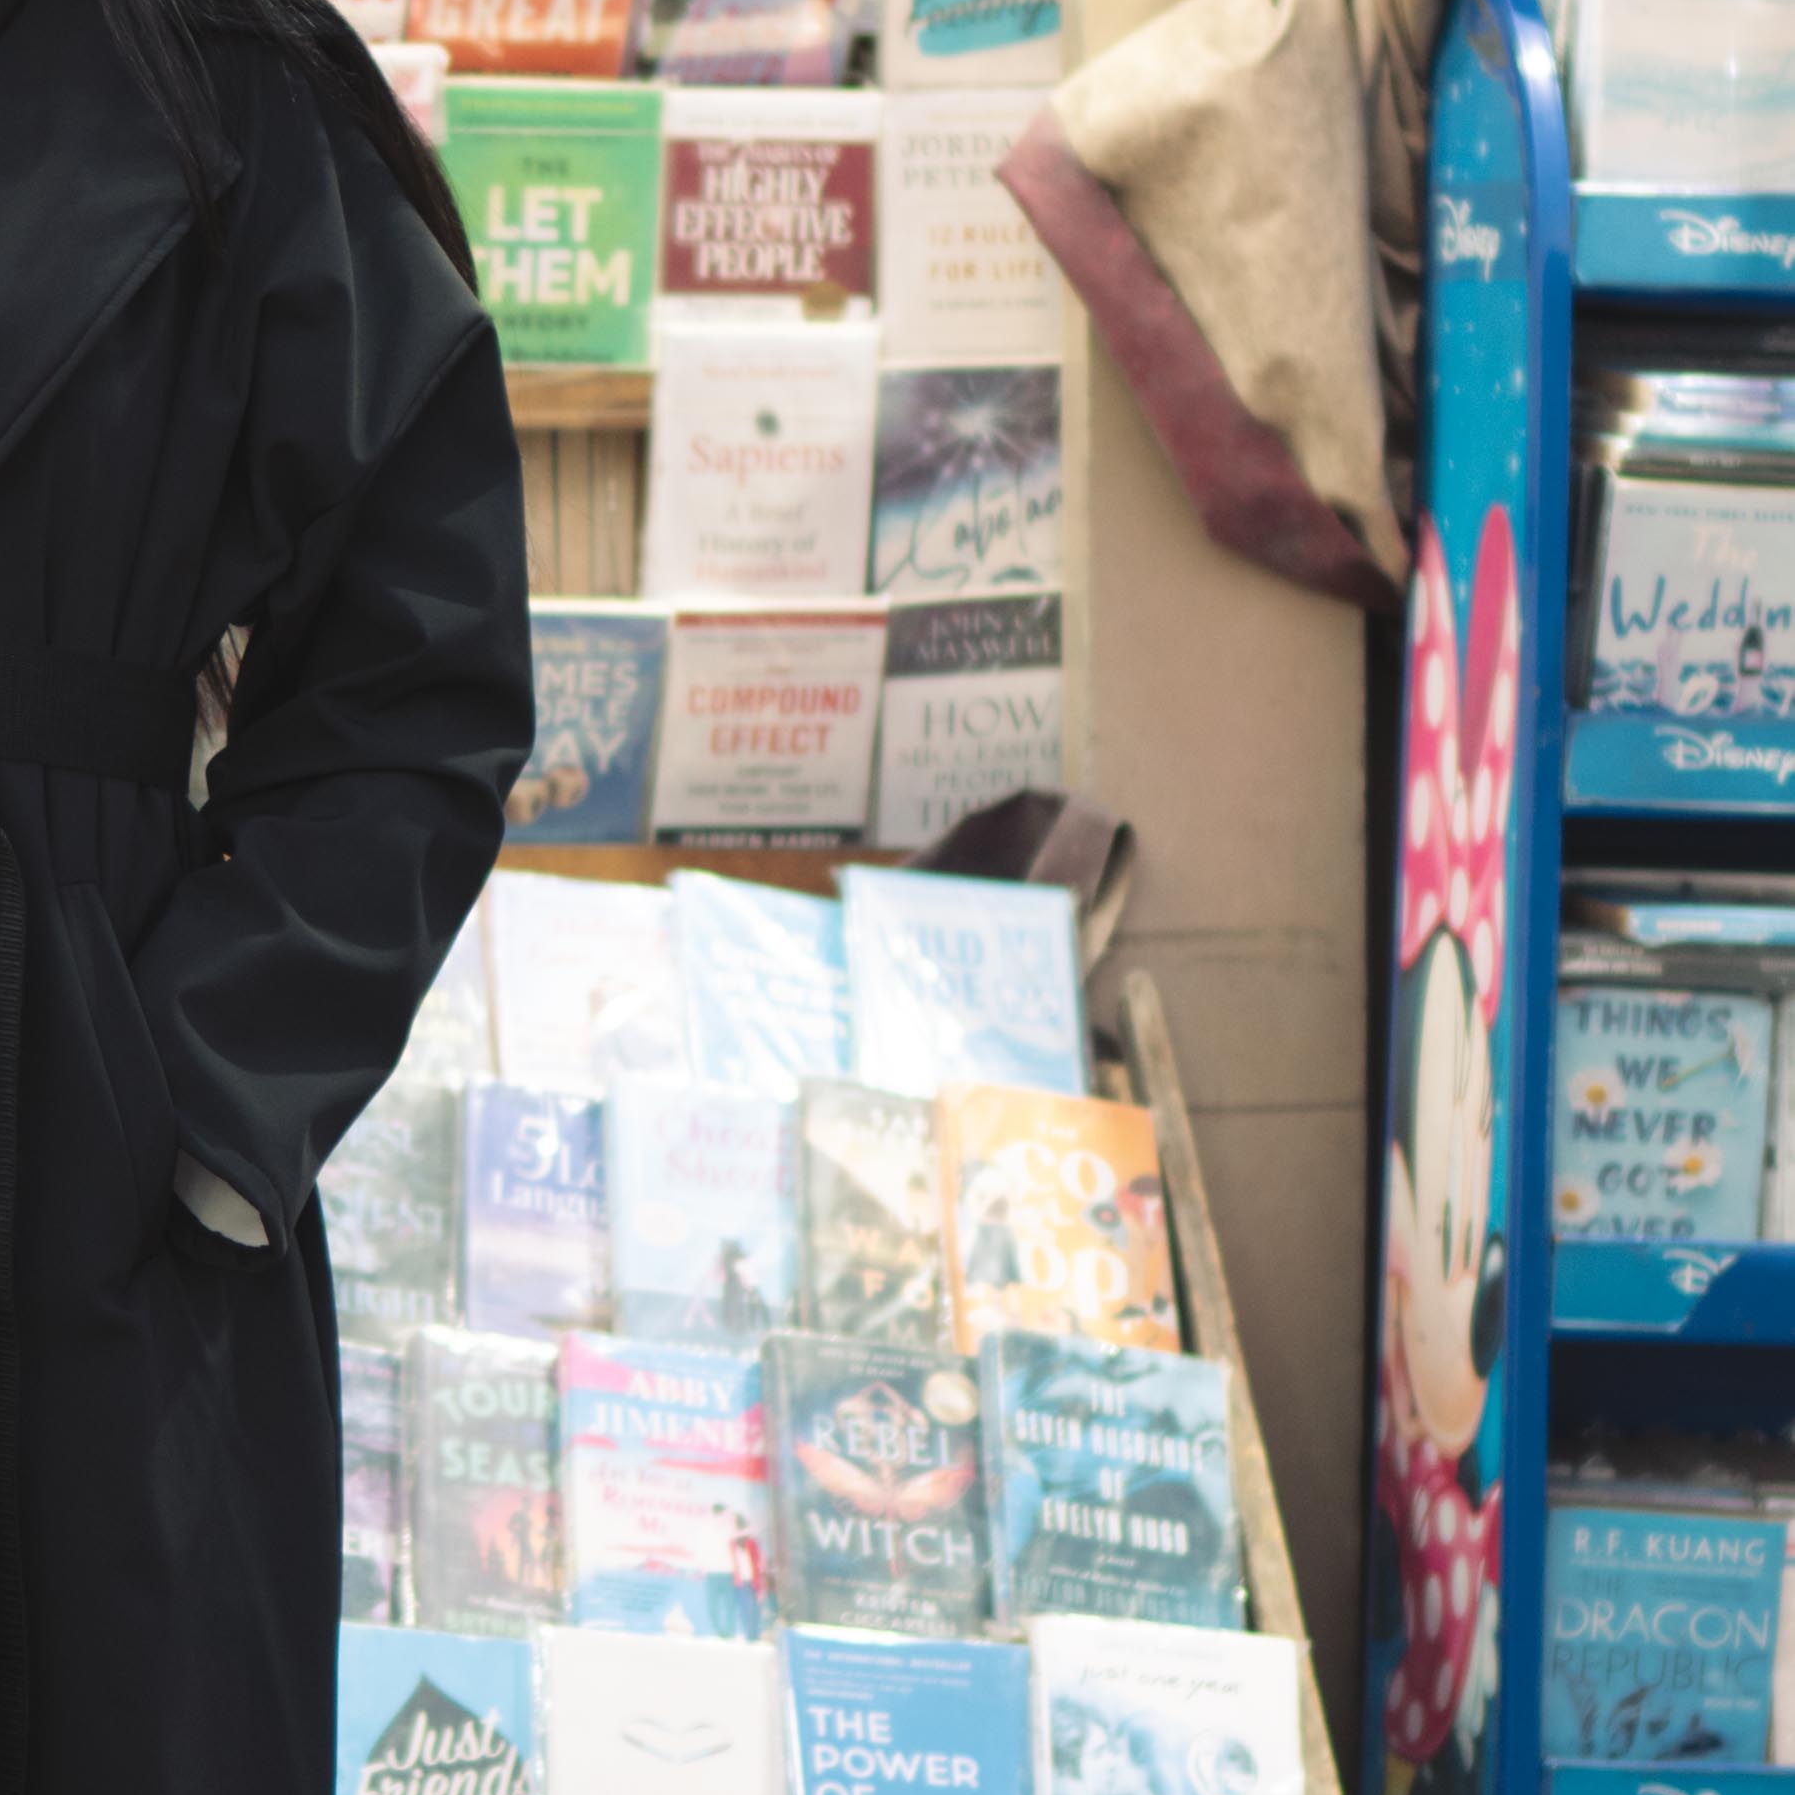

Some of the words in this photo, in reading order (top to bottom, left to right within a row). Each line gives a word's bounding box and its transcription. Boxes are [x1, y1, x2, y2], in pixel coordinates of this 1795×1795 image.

[704, 165, 827, 204] HIGHLY
[488, 184, 603, 244] LET
[674, 201, 853, 244] EFFECTIVE
[698, 241, 825, 281] PEOPLE
[685, 431, 848, 487] Sapiens
[1611, 574, 1795, 638] Weddin
[687, 684, 861, 718] COMPOUND
[921, 694, 1051, 739] HOW
[710, 723, 836, 757] EFFECT
[1577, 999, 1734, 1043] THINGS
[1615, 1054, 1682, 1093] WE
[1572, 1109, 1718, 1148] NEVER
[626, 1369, 737, 1413] ABBY
[1090, 1382, 1127, 1417] THE
[812, 1413, 963, 1469] REBEL
[1015, 1410, 1083, 1451] SEVEN
[1090, 1424, 1205, 1473] HUSBANDS
[440, 1437, 549, 1492] SEAS
[1099, 1469, 1125, 1502] OF
[806, 1510, 975, 1568] WITCH
[1042, 1497, 1123, 1545] EVELYN
[1130, 1513, 1189, 1557] HUGO
[1646, 1534, 1768, 1566] KUANG
[1552, 1597, 1771, 1652] DRAGON
[1551, 1644, 1769, 1695] REPUBLIC
[386, 1705, 506, 1772] Just
[807, 1706, 892, 1746] THE
[811, 1744, 980, 1791] POWER
